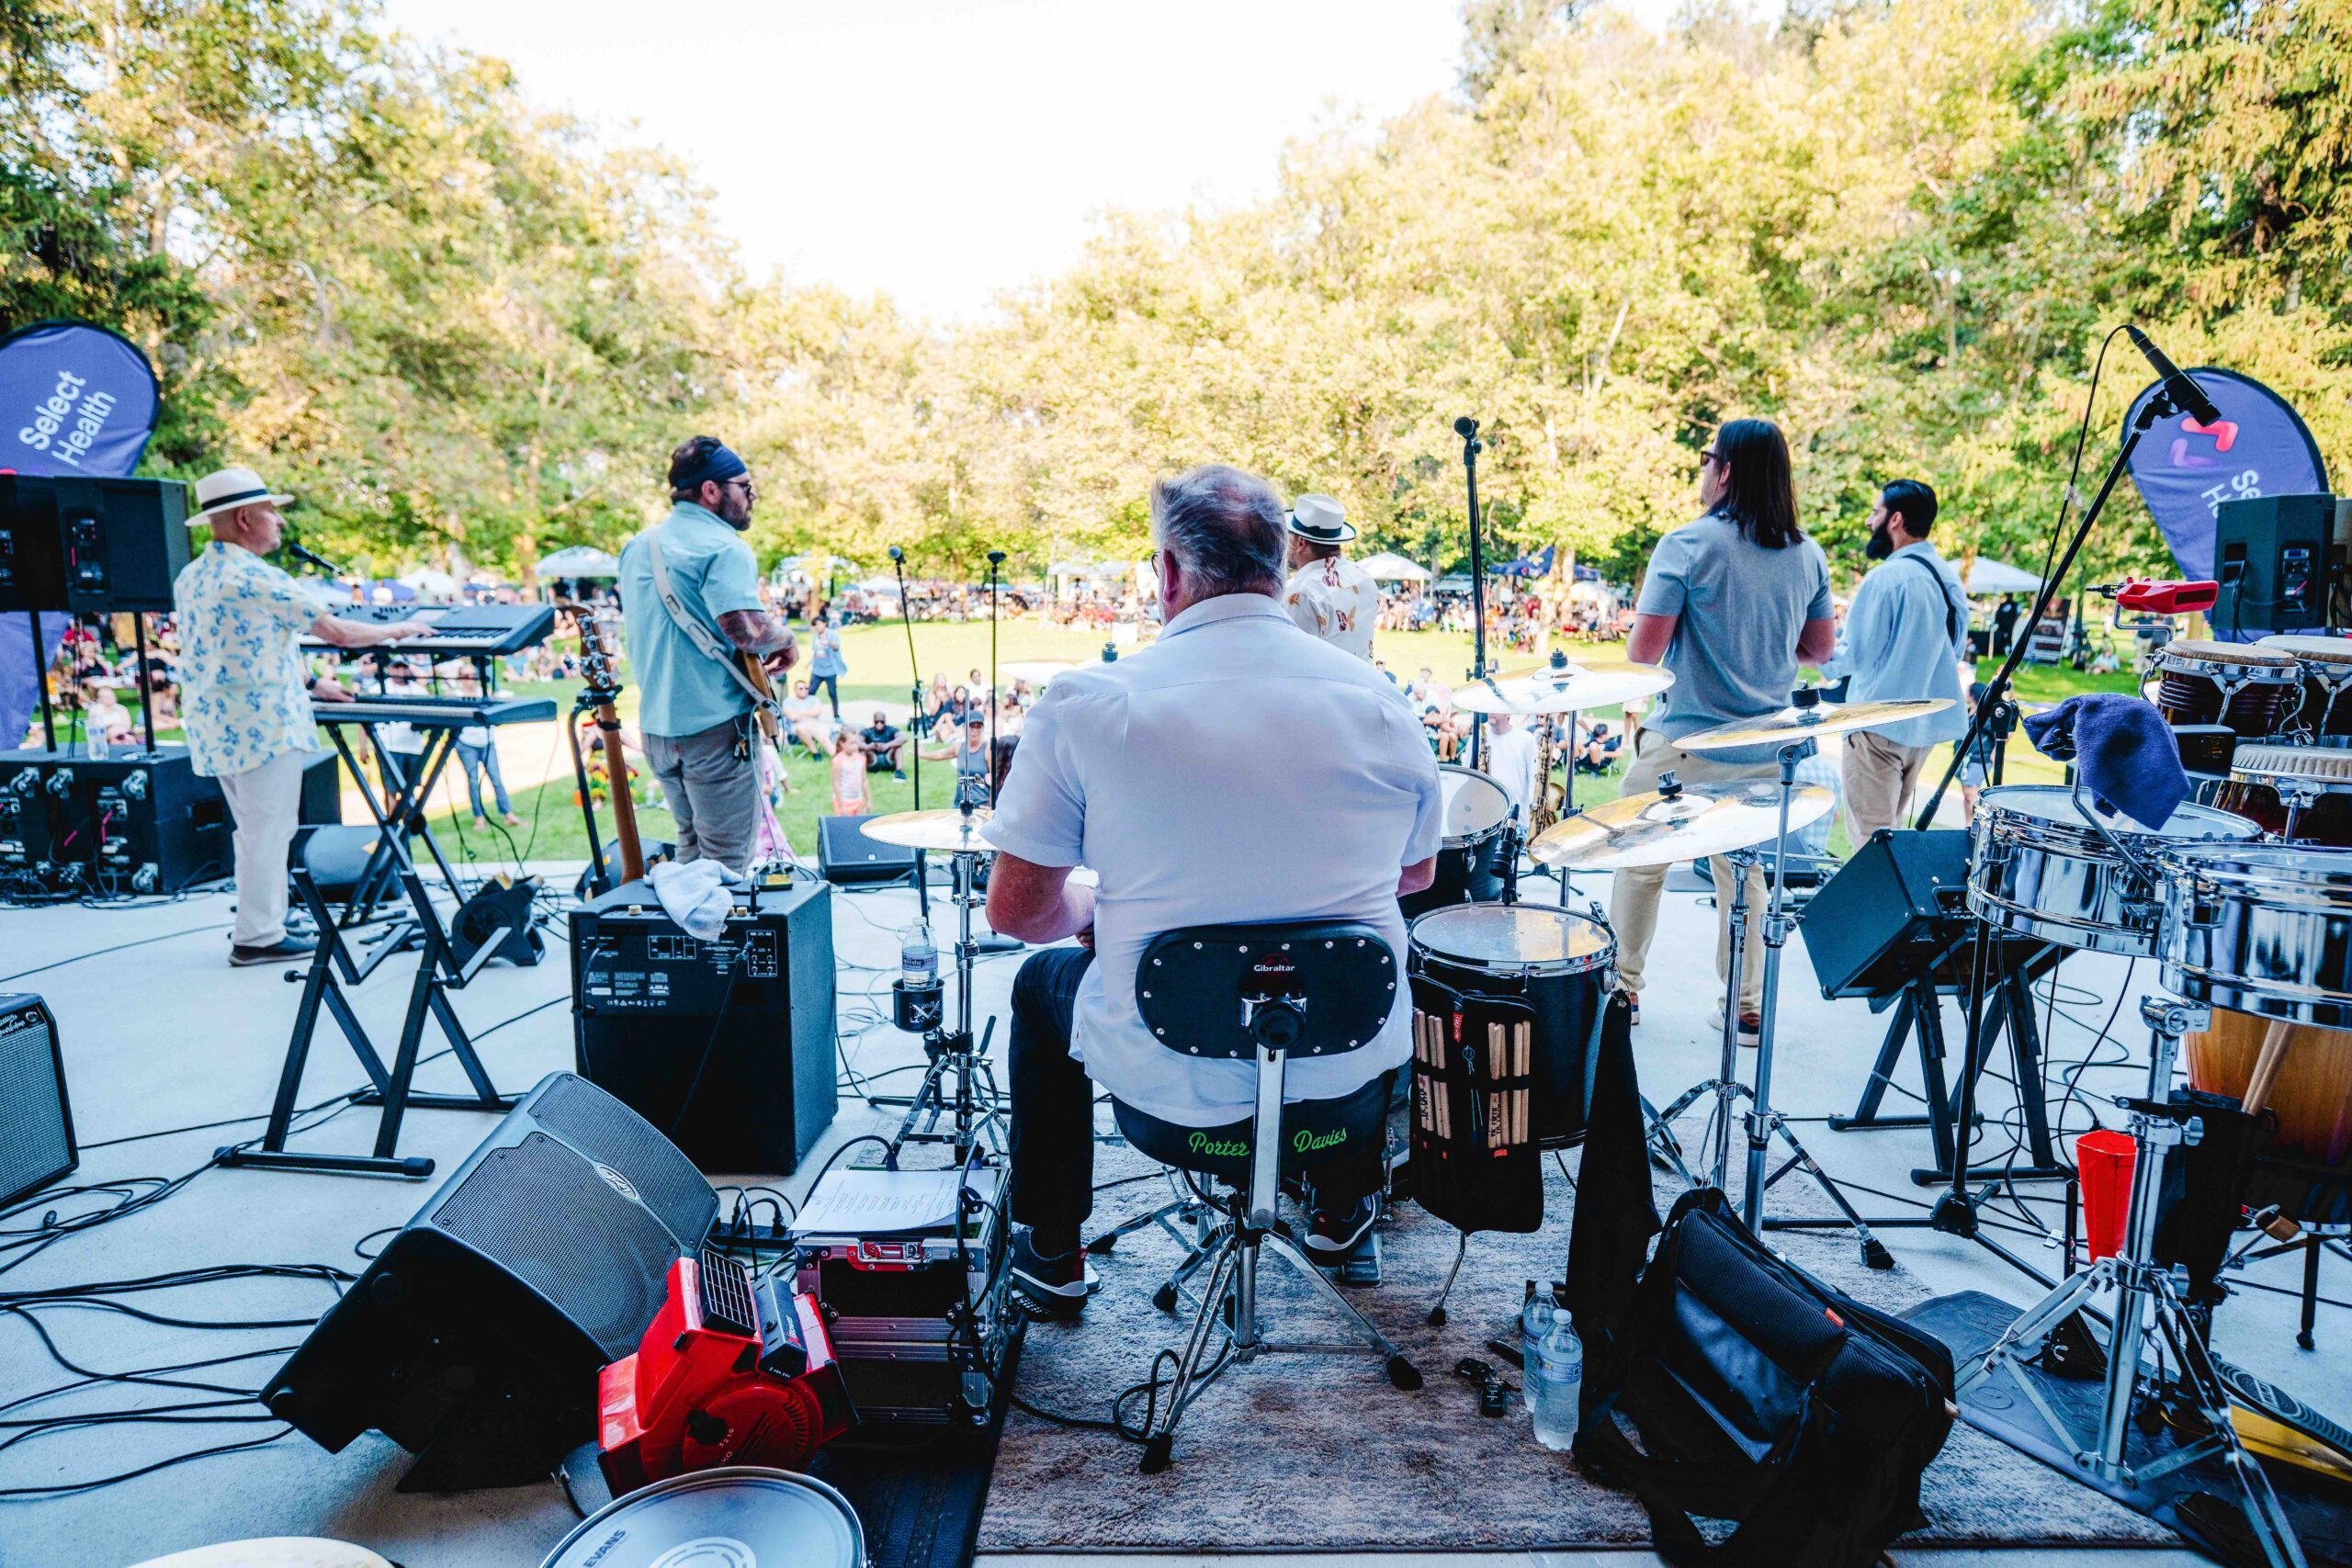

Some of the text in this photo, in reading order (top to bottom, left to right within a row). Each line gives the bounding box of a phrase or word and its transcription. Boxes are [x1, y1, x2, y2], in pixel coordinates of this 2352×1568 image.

[18, 369, 86, 450] Select
[51, 391, 117, 467] Health
[1253, 964, 1295, 972] Gibraltar
[1189, 1127, 1347, 1156] Porter Davies
[582, 1529, 627, 1568] EVANS
